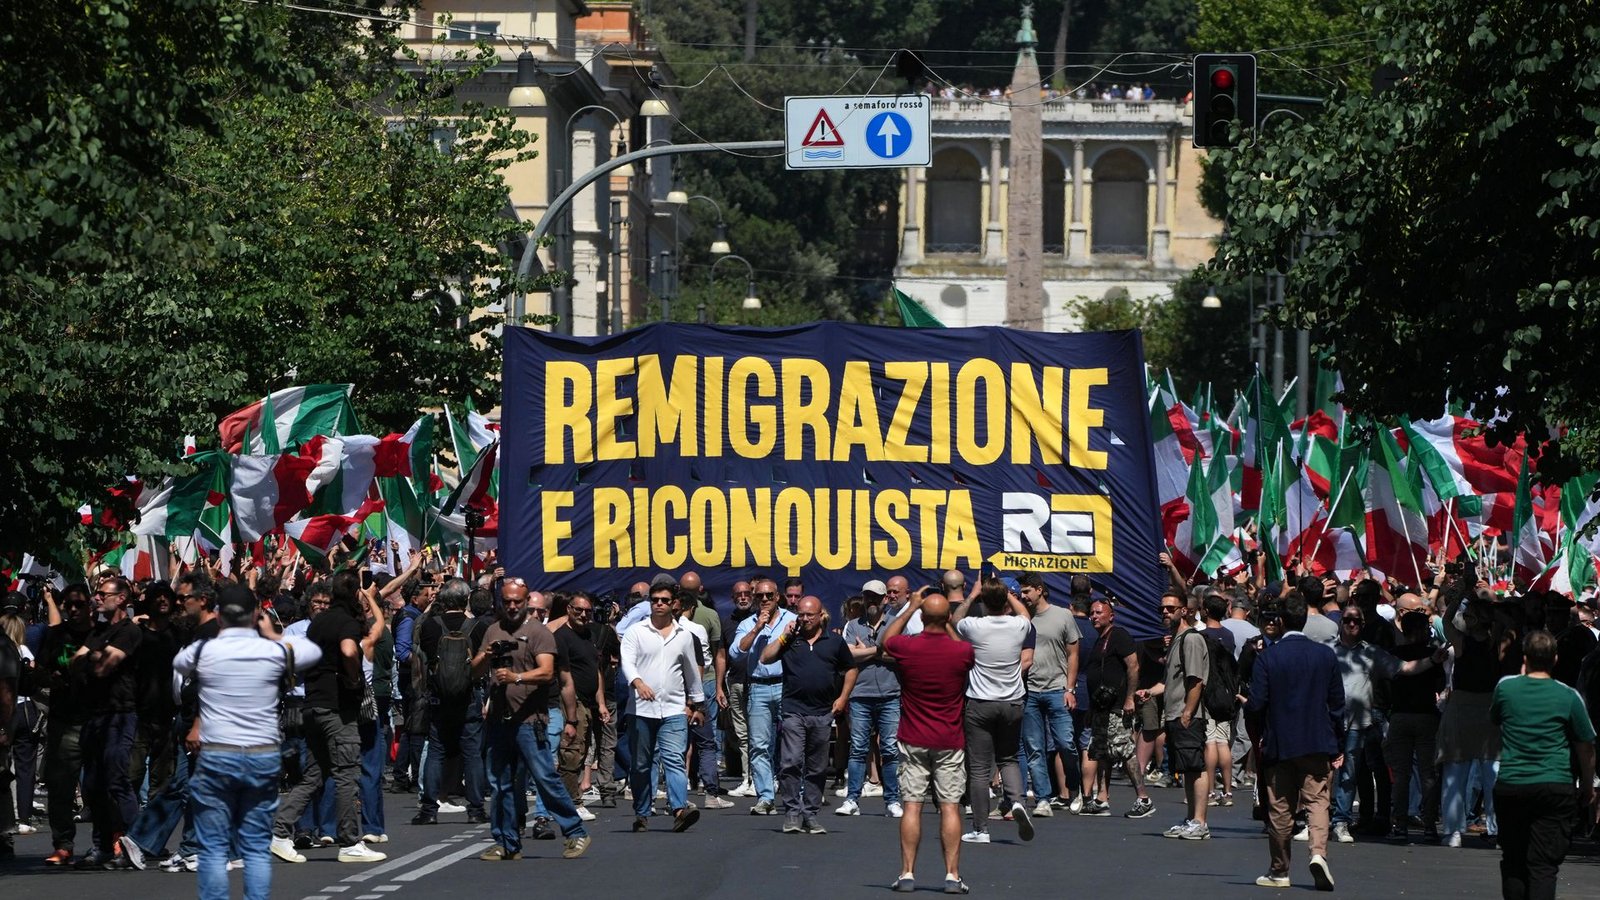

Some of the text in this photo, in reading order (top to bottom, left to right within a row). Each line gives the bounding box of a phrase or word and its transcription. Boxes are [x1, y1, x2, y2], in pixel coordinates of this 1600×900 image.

[853, 100, 896, 110] semaforo
[899, 101, 923, 109] rosso
[544, 353, 1109, 470] REMIGRAZIONE
[541, 484, 984, 578] E RICONQUISTA
[1002, 491, 1095, 554] RE
[1004, 555, 1089, 570] MIGRAZIONE
